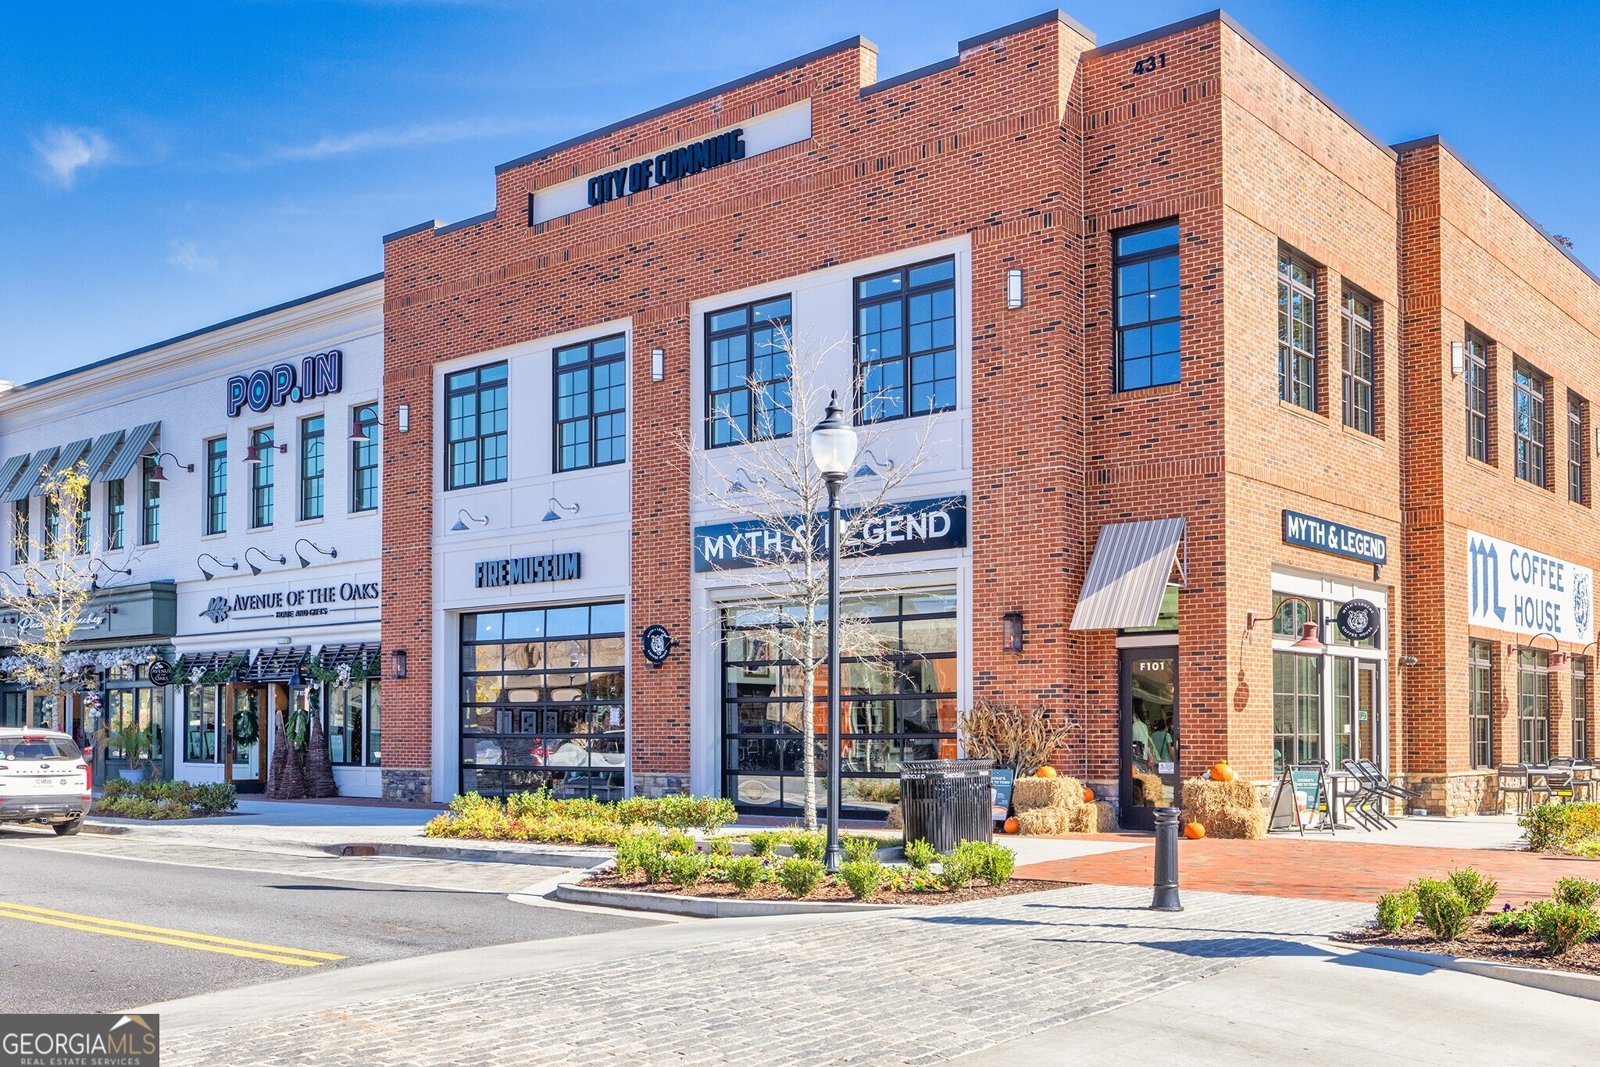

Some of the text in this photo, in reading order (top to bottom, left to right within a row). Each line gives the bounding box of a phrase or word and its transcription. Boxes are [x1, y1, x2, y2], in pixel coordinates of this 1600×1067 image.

[1133, 53, 1166, 75] 431
[588, 128, 746, 206] CITY OF CUMMING
[227, 350, 343, 417] POP.IN
[703, 529, 781, 561] MYTH
[1288, 515, 1386, 559] MYTH & LEGEND
[475, 552, 581, 588] FIRE MUSEUM
[1510, 548, 1564, 592] COFFEE
[233, 582, 379, 612] AVENUE OF THE OAKS
[1514, 594, 1562, 633] HOUSE
[1140, 662, 1165, 671] F101
